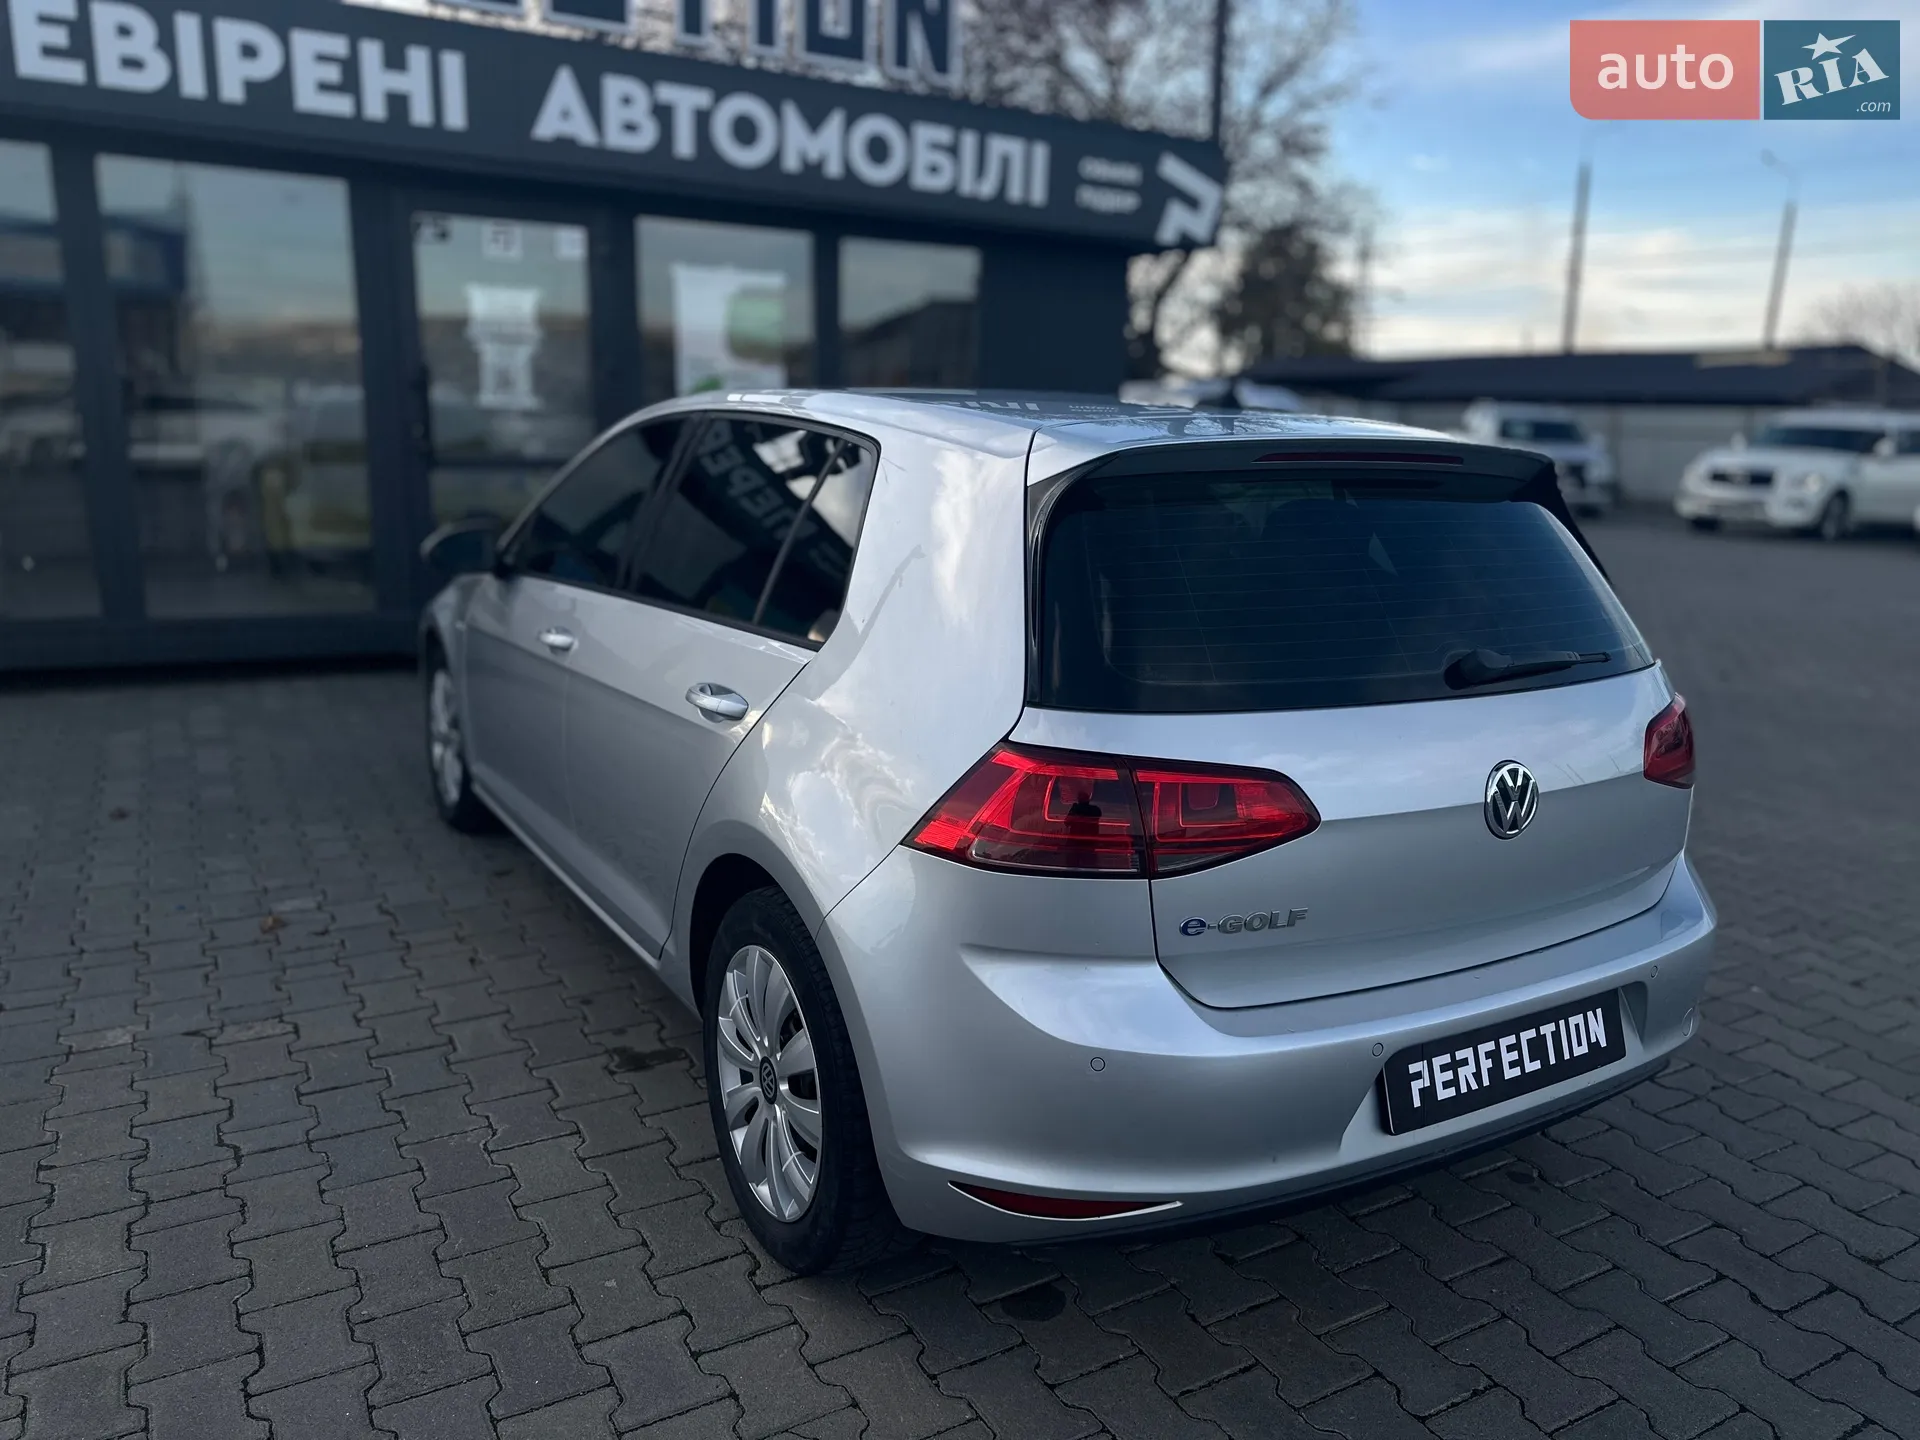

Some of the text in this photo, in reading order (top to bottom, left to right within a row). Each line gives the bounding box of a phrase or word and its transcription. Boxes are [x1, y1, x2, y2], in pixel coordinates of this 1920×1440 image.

[531, 64, 1051, 208] АВТОМОБІЛІ
[1179, 907, 1308, 936] e-GOLF
[1408, 1007, 1607, 1108] PERFECTION
